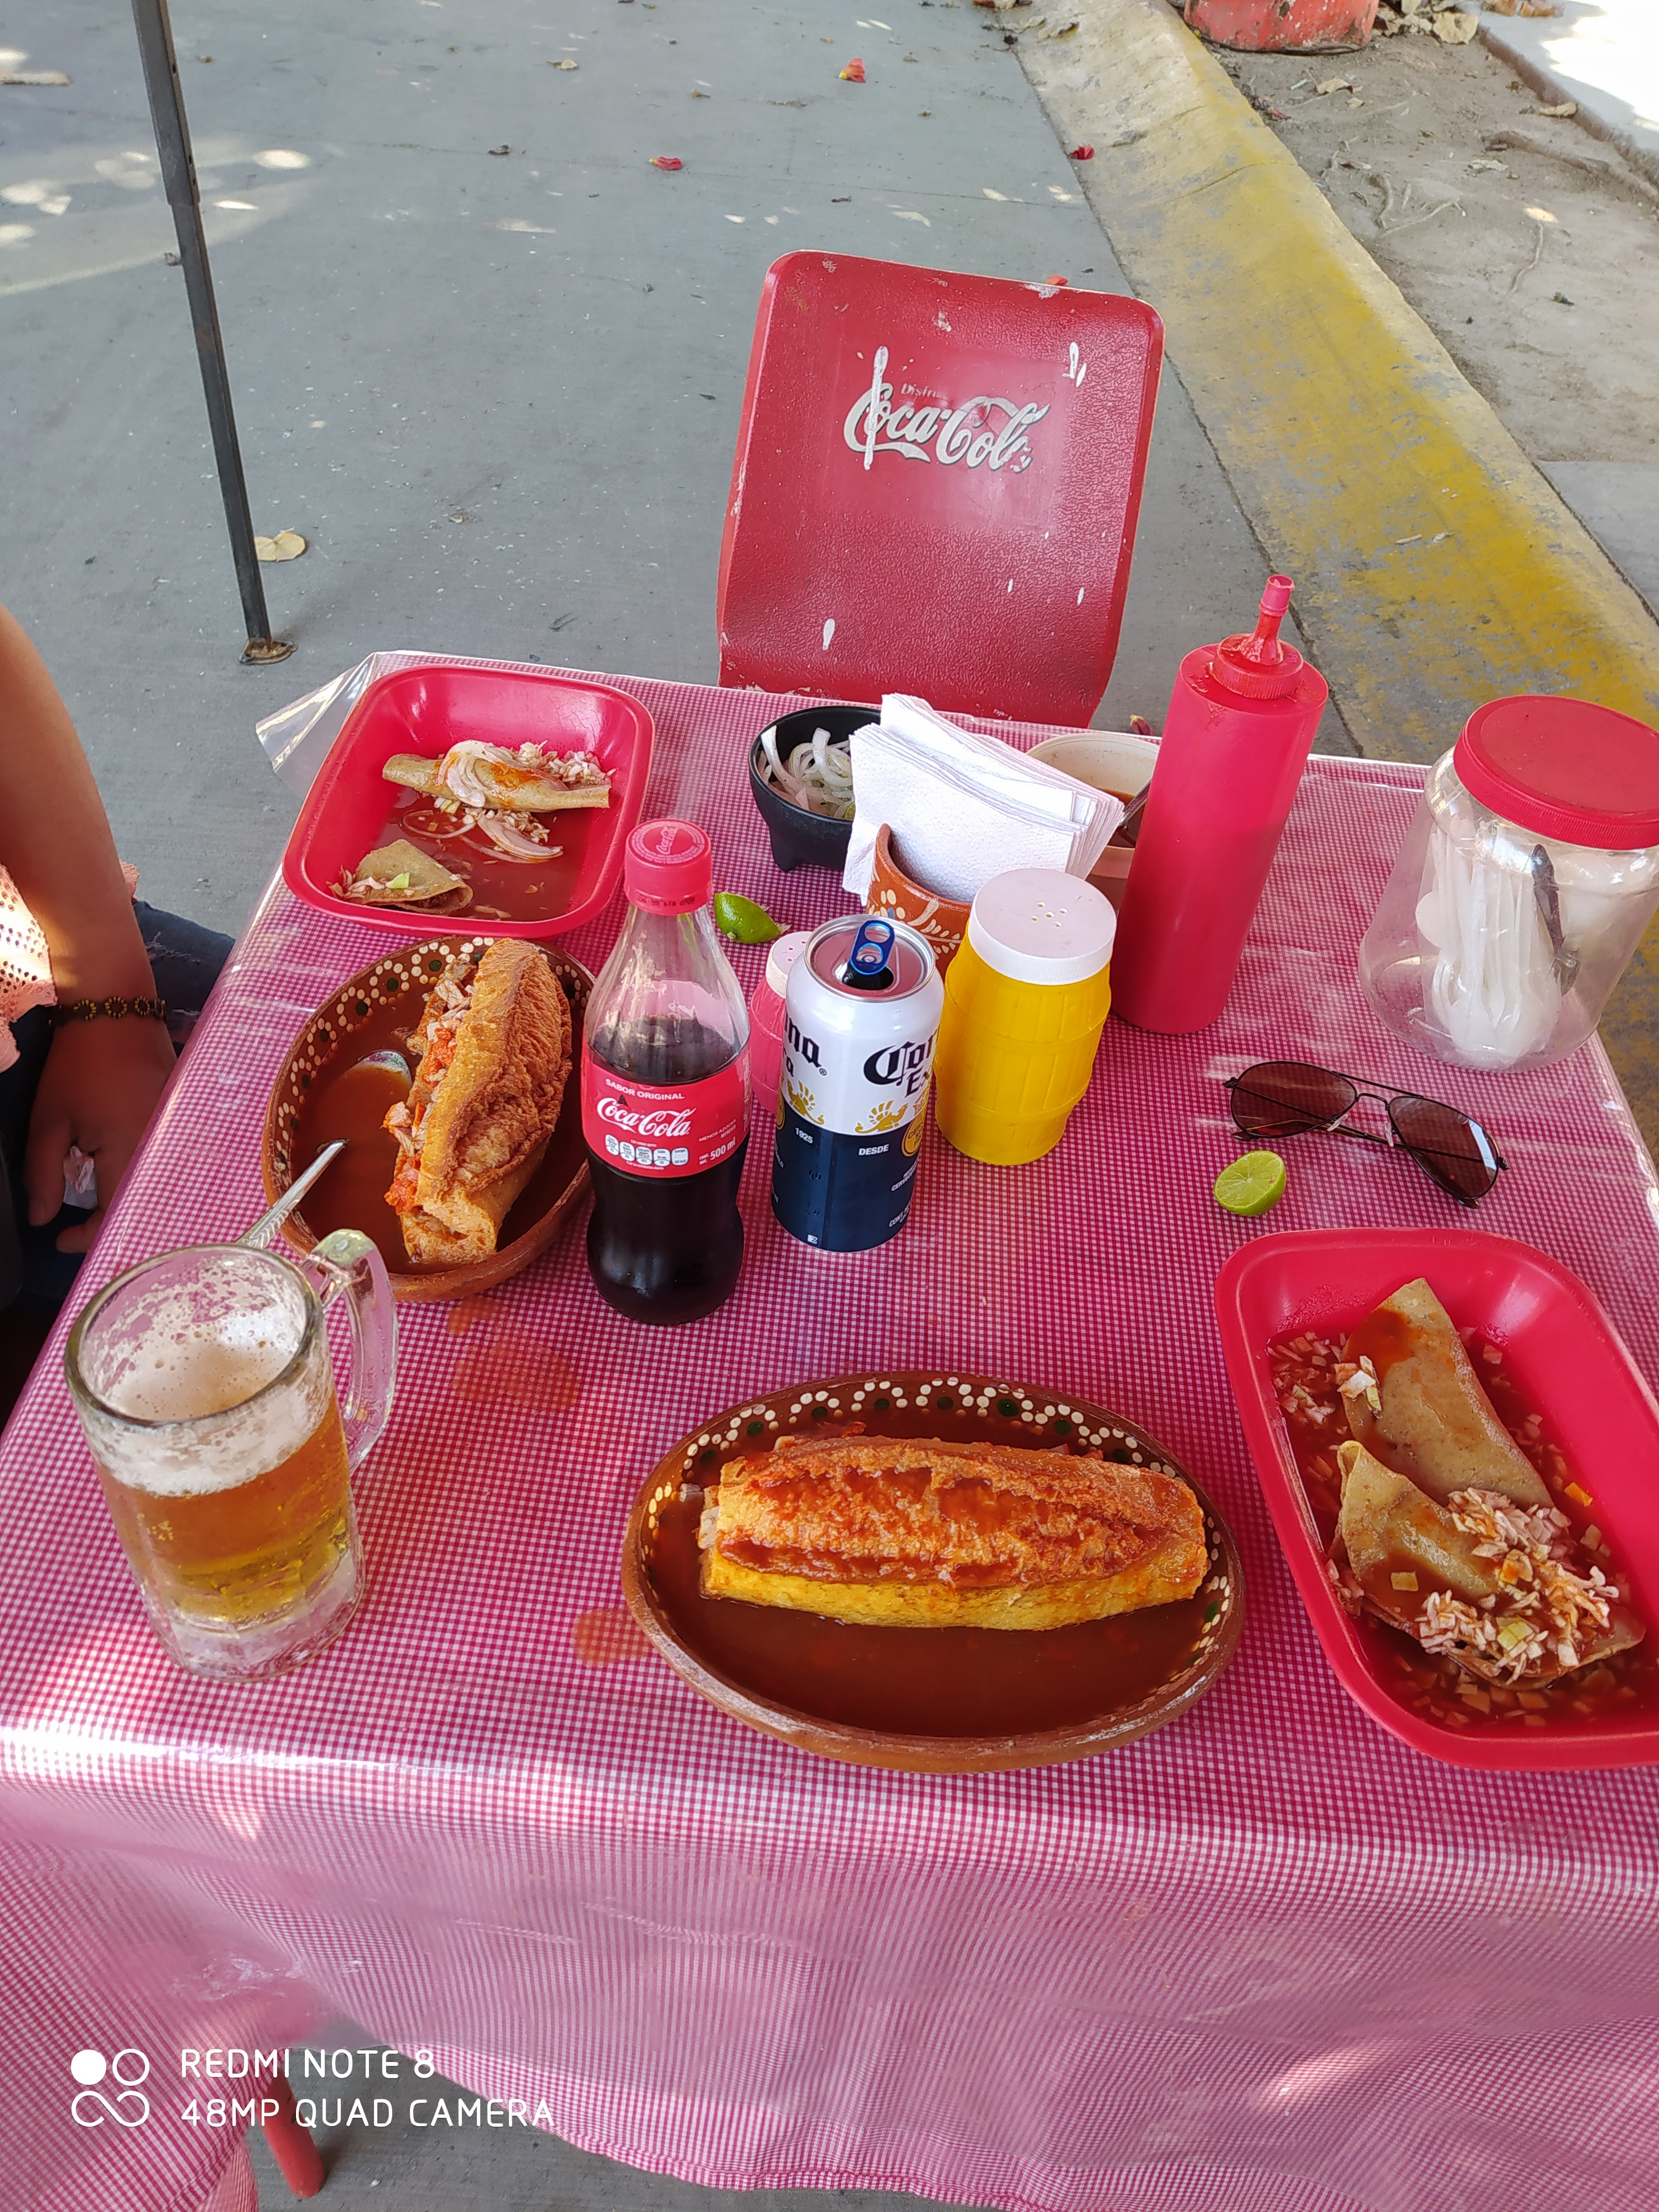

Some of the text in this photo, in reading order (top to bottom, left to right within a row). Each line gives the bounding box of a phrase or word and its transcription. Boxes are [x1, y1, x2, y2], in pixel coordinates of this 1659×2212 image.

[605, 1078, 685, 1100] SABOR ORIGINAL
[597, 1097, 697, 1137] Coca-Cola
[699, 1131, 718, 1142] MENOS
[795, 1127, 814, 1144] 1925
[710, 1136, 735, 1160] 500 ml
[859, 1144, 889, 1156] DESDE
